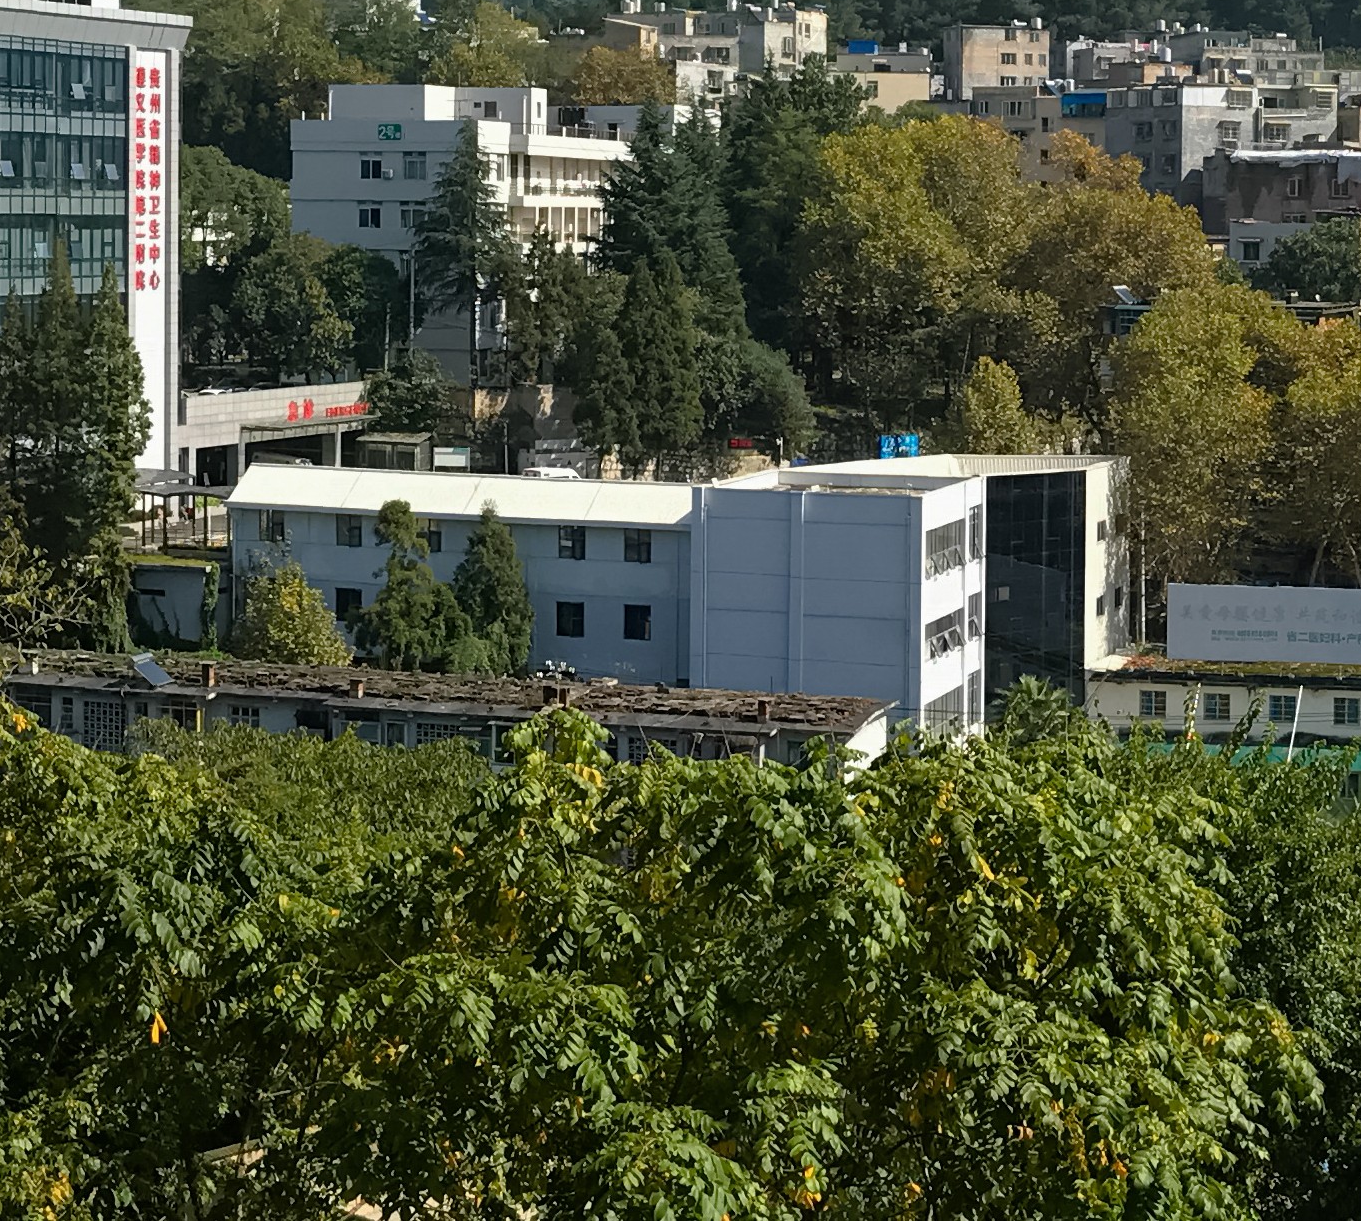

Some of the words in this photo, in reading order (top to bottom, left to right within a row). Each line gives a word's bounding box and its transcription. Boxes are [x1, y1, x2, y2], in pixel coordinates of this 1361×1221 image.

[149, 68, 161, 290] 贵州省精神卫生中心
